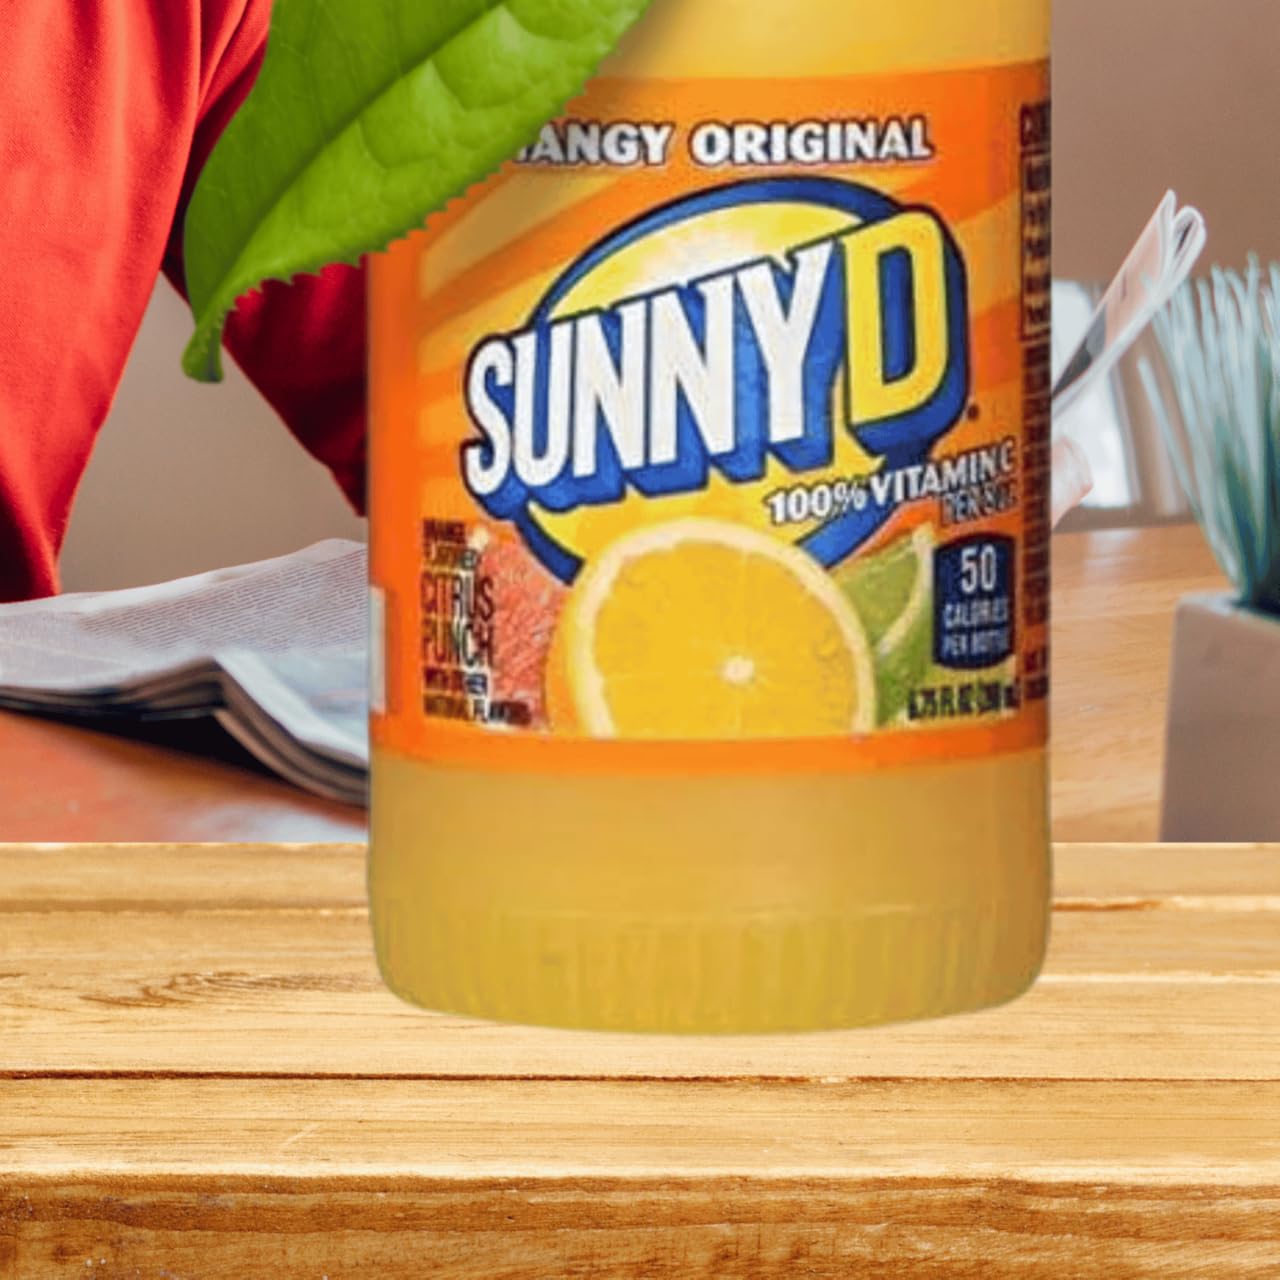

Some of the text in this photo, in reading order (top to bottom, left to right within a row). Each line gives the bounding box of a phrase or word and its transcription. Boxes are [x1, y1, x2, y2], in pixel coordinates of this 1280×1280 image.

[517, 115, 934, 167] ANGY ORIGINAL
[765, 475, 870, 526] 100%
[869, 446, 1001, 508] VITAMIN
[999, 436, 1016, 473] C
[960, 544, 997, 594] 50
[420, 572, 494, 622] CITRUS
[422, 619, 494, 667] PUNCH
